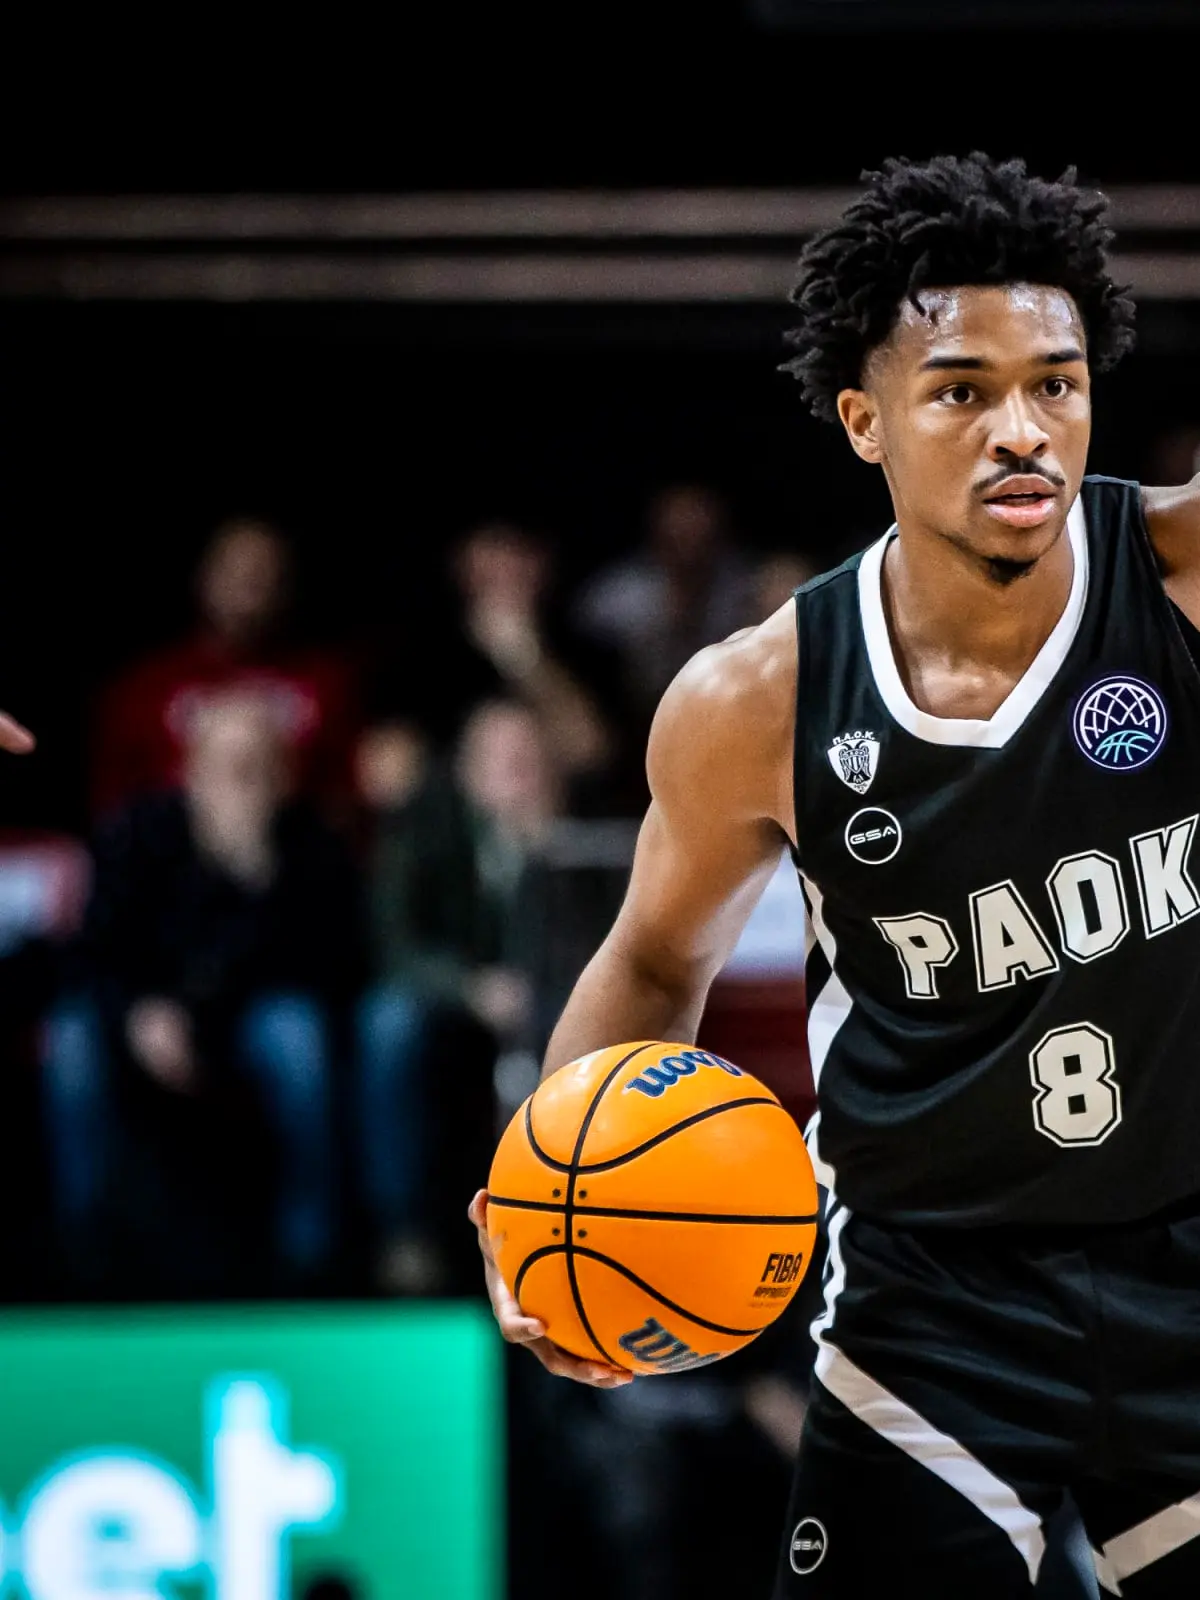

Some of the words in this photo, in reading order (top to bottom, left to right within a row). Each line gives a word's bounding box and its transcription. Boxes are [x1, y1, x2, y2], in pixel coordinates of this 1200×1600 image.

[850, 825, 897, 845] GSA
[1028, 1021, 1122, 1147] 8
[761, 1252, 803, 1283] FIBA
[0, 1370, 342, 1600] et
